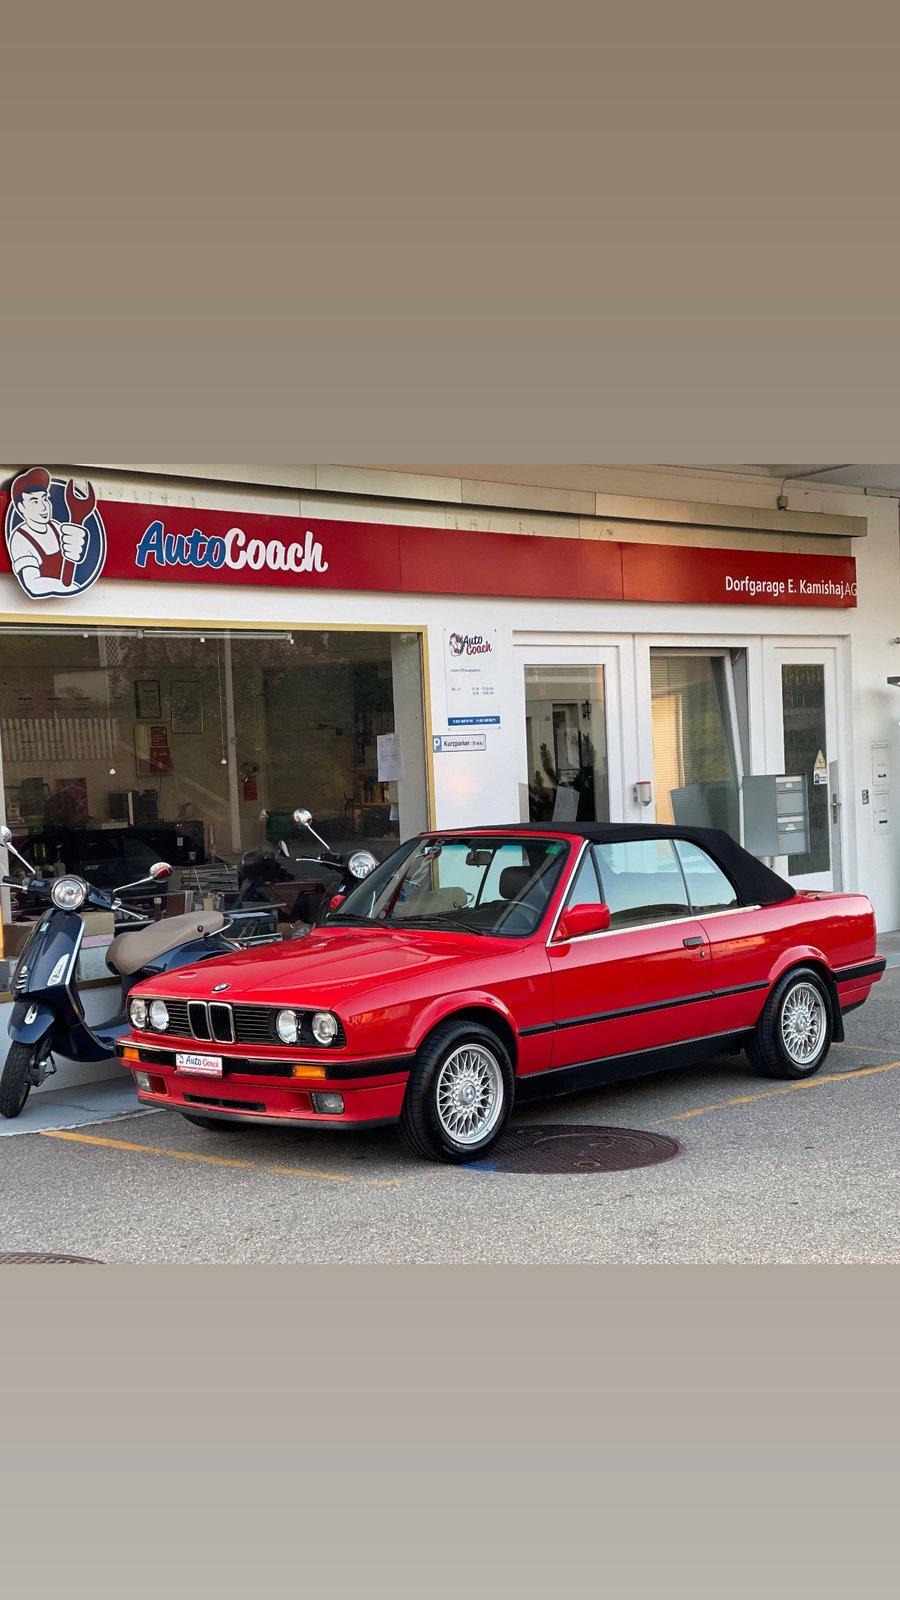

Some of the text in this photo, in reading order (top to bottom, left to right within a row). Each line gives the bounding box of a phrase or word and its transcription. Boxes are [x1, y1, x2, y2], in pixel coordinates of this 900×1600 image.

[725, 575, 785, 596] Dorfgarage
[787, 578, 797, 594] E.
[799, 579, 844, 599] Kamishaj
[463, 634, 483, 645] Auto
[466, 640, 492, 656] Coach
[185, 1055, 202, 1066] Auto
